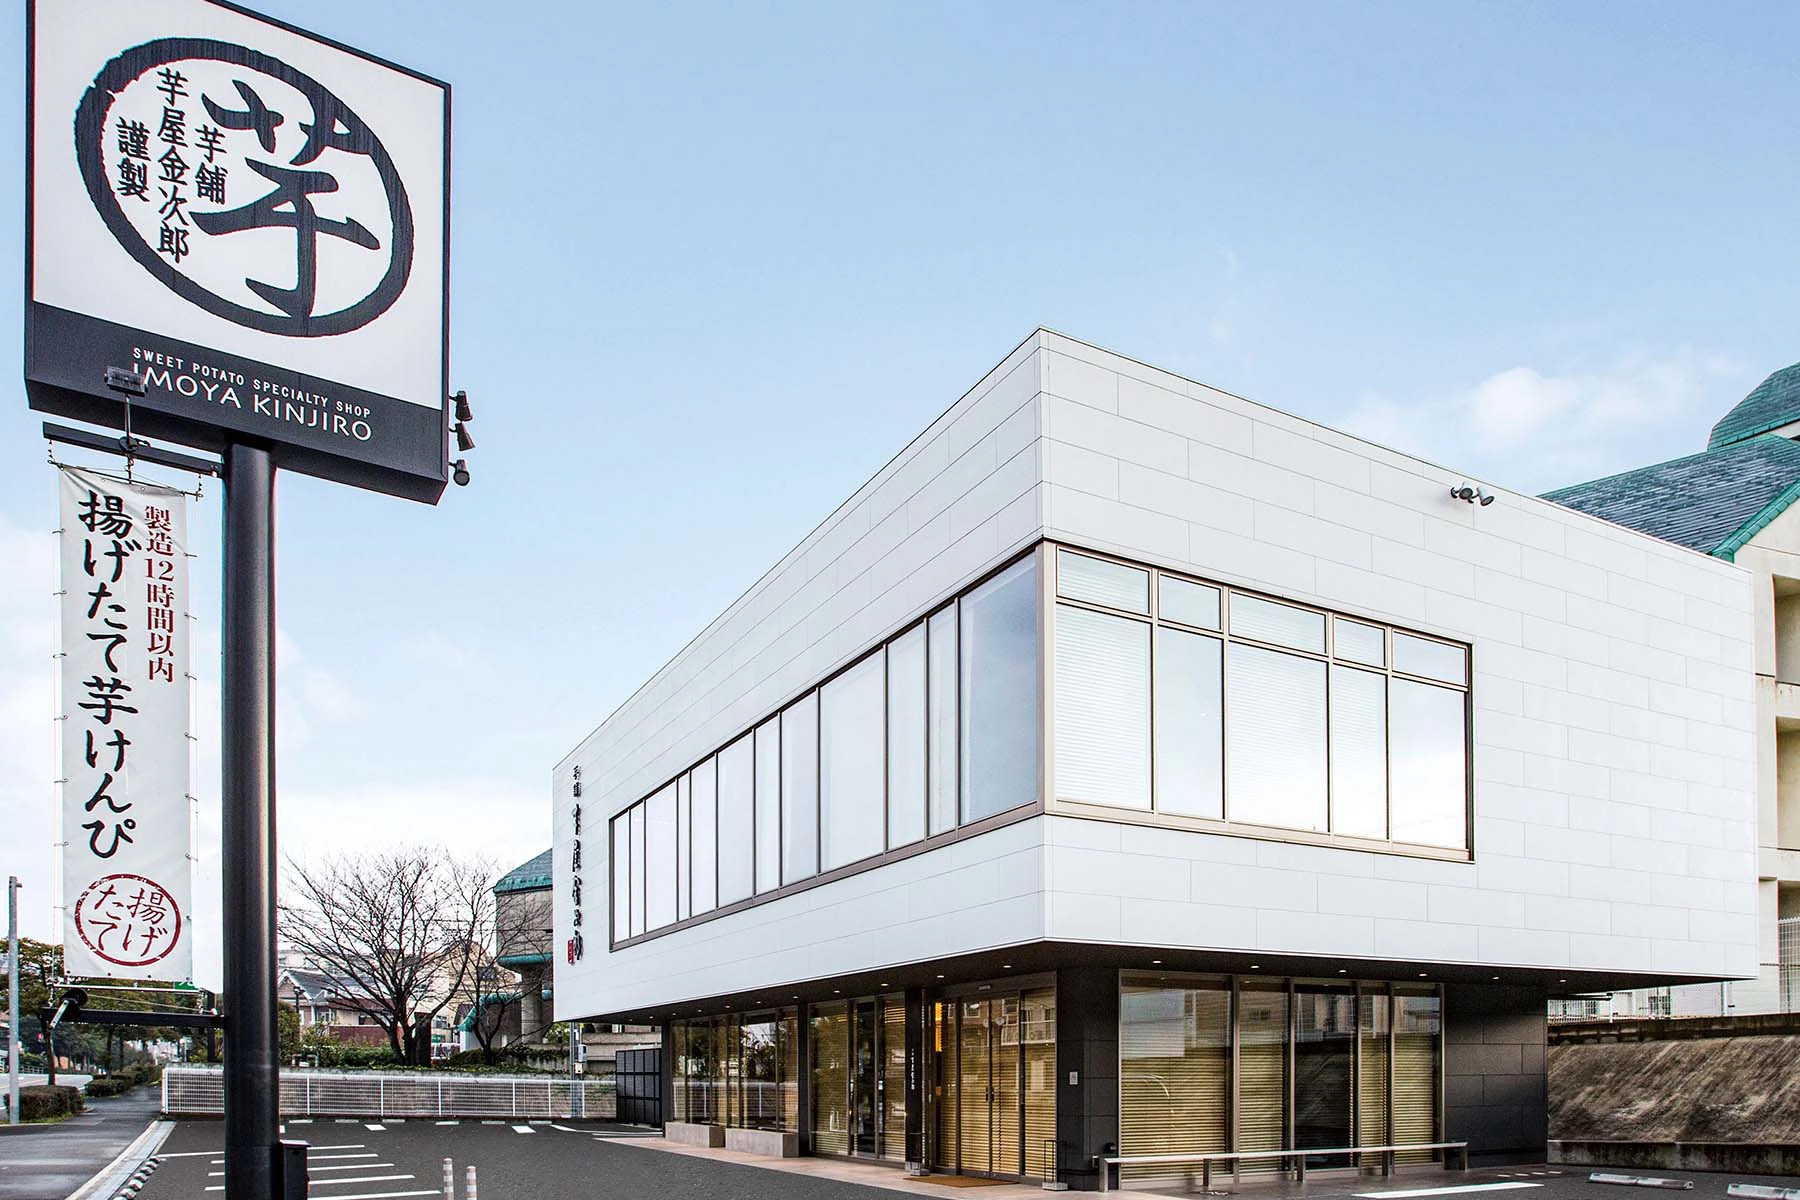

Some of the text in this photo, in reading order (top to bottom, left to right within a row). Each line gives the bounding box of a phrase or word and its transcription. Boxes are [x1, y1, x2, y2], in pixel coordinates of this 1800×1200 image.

[116, 116, 151, 202] 謹製
[156, 67, 190, 264] 芋屋金次郎
[132, 347, 371, 419] SWEET POTATO SPECIALTY SHOP
[133, 362, 372, 442] IMOYA KINJIRO
[144, 504, 175, 683] 製造12時間以内
[77, 489, 141, 859] 揚げたて芋けんぴ
